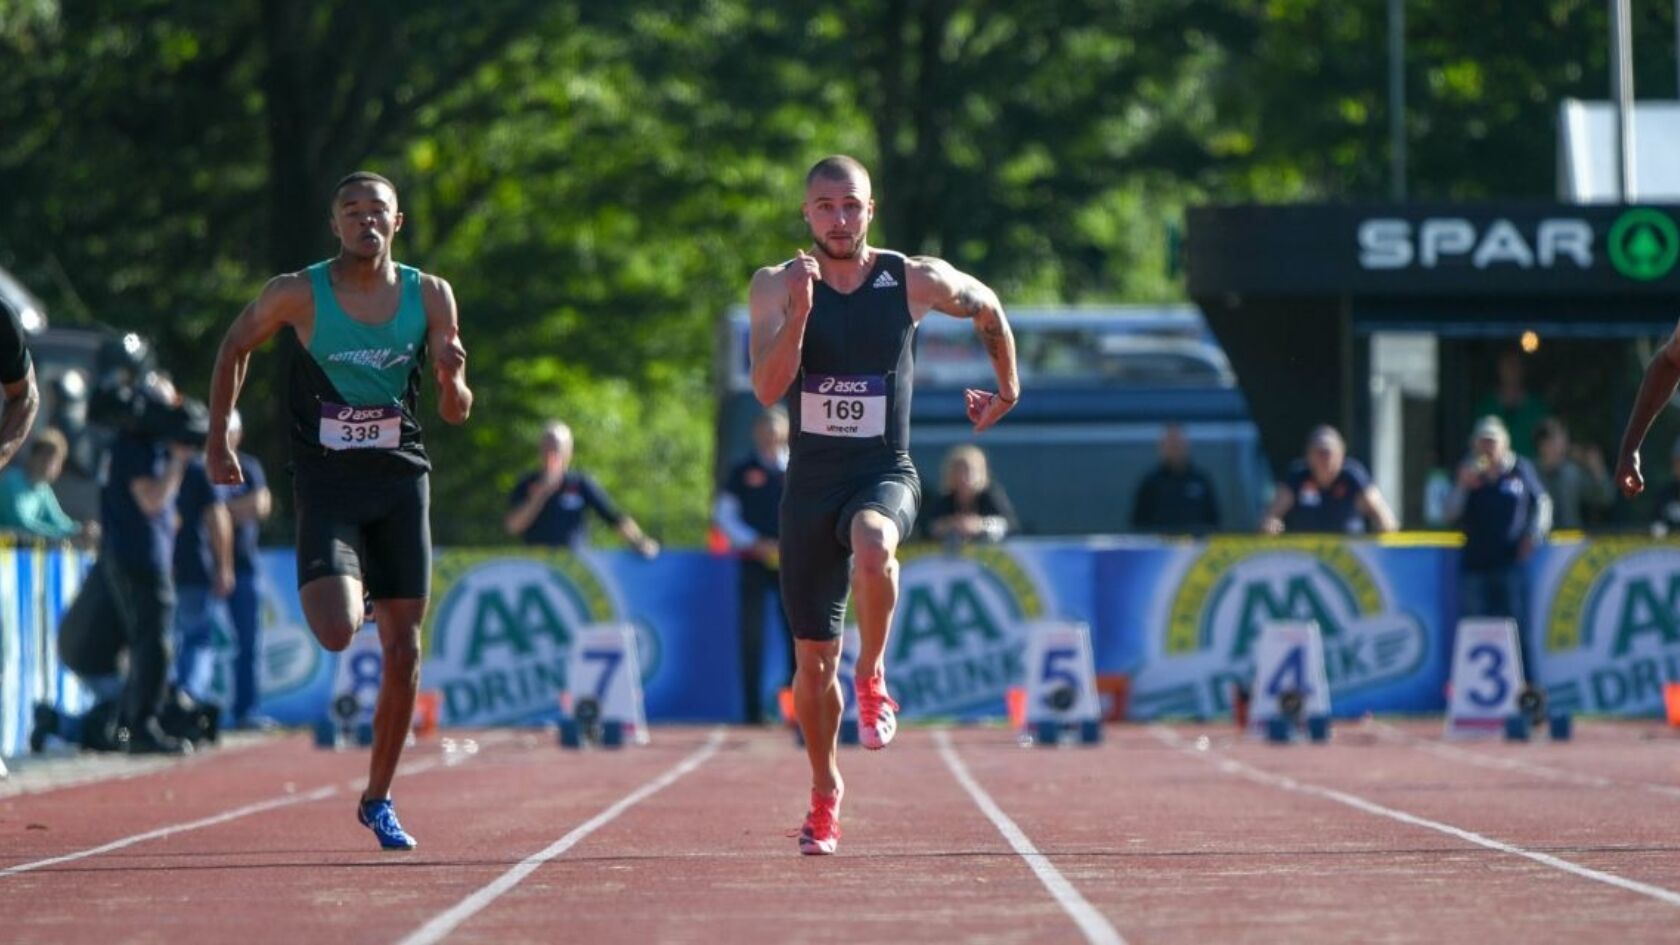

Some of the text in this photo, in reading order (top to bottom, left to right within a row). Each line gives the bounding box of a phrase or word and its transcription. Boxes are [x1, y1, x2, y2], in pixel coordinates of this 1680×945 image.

[1359, 219, 1594, 269] SPAR
[822, 399, 864, 420] 169
[834, 380, 868, 393] asics
[341, 424, 380, 442] 338
[352, 408, 384, 420] asics
[464, 584, 573, 668] AA
[894, 577, 1003, 662] AA
[1610, 573, 1680, 656] A
[351, 641, 383, 693] 8
[443, 656, 568, 721] DRIN
[581, 649, 624, 704] 7
[1040, 649, 1080, 708] 5
[1266, 645, 1315, 697] 4
[1466, 643, 1511, 708] 3
